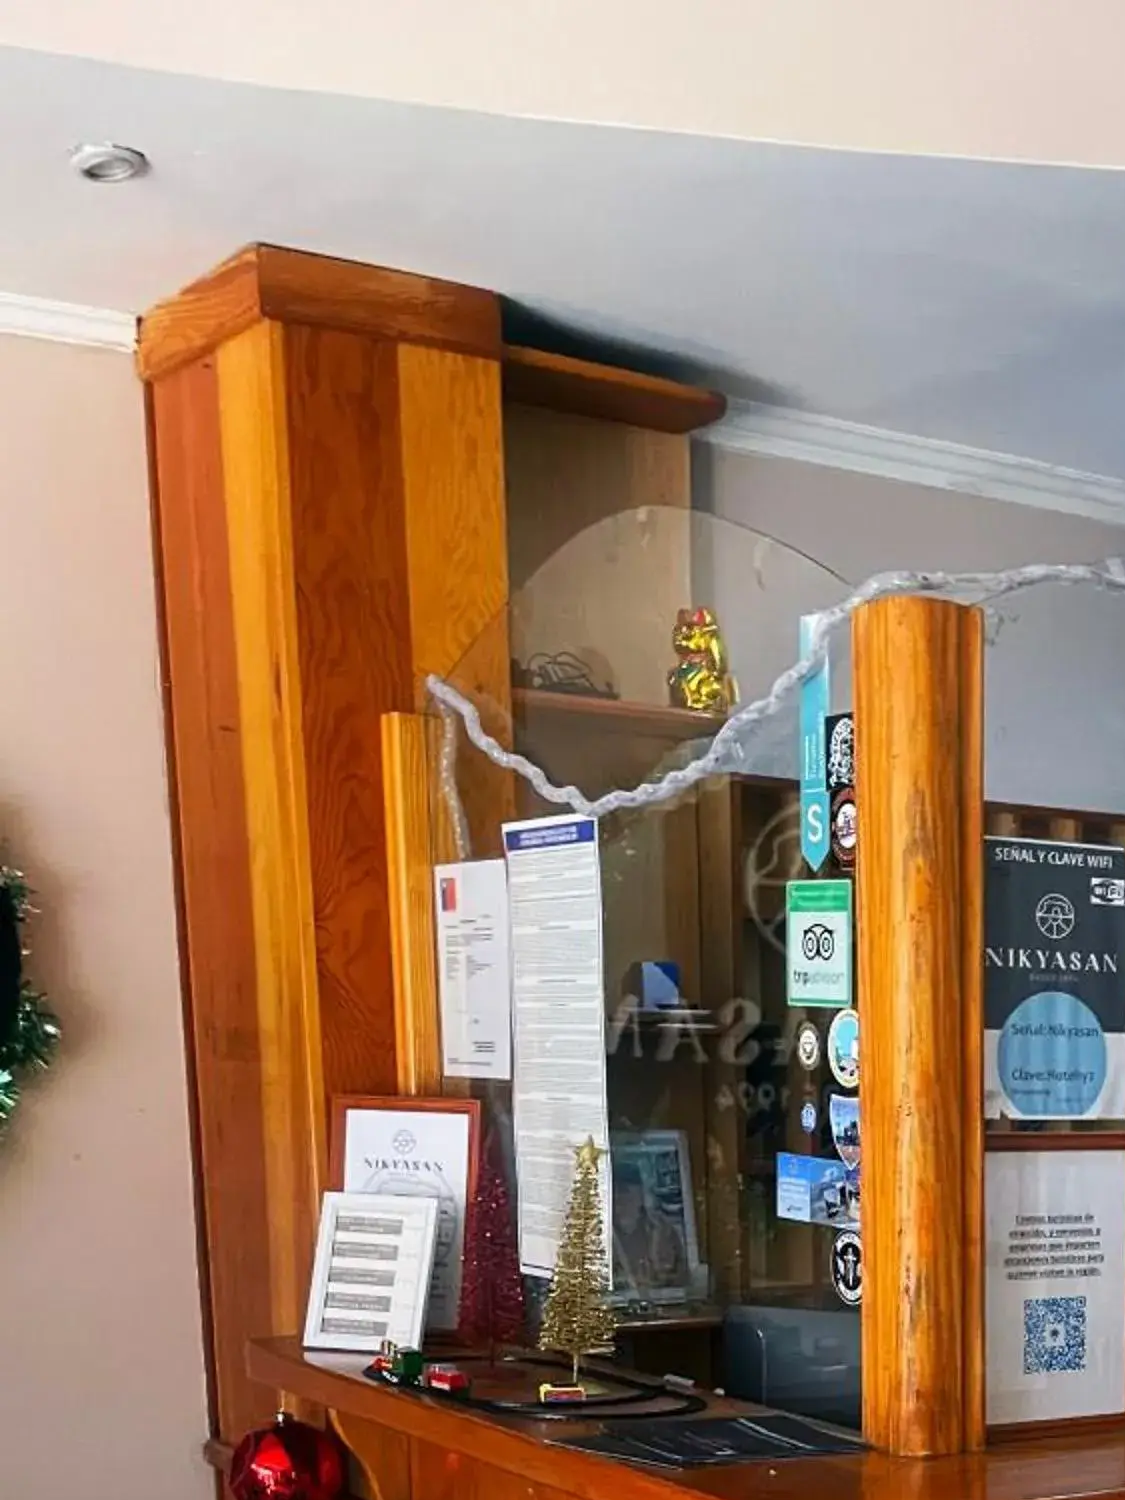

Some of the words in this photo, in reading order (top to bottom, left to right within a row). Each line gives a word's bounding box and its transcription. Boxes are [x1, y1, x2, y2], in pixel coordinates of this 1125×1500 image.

[806, 803, 824, 843] S
[995, 845, 1036, 863] SEÑAL
[1037, 850, 1046, 864] Y
[1047, 851, 1085, 867] CLAVE
[1087, 855, 1113, 868] WIFI
[986, 947, 1118, 973] NIKYASAN
